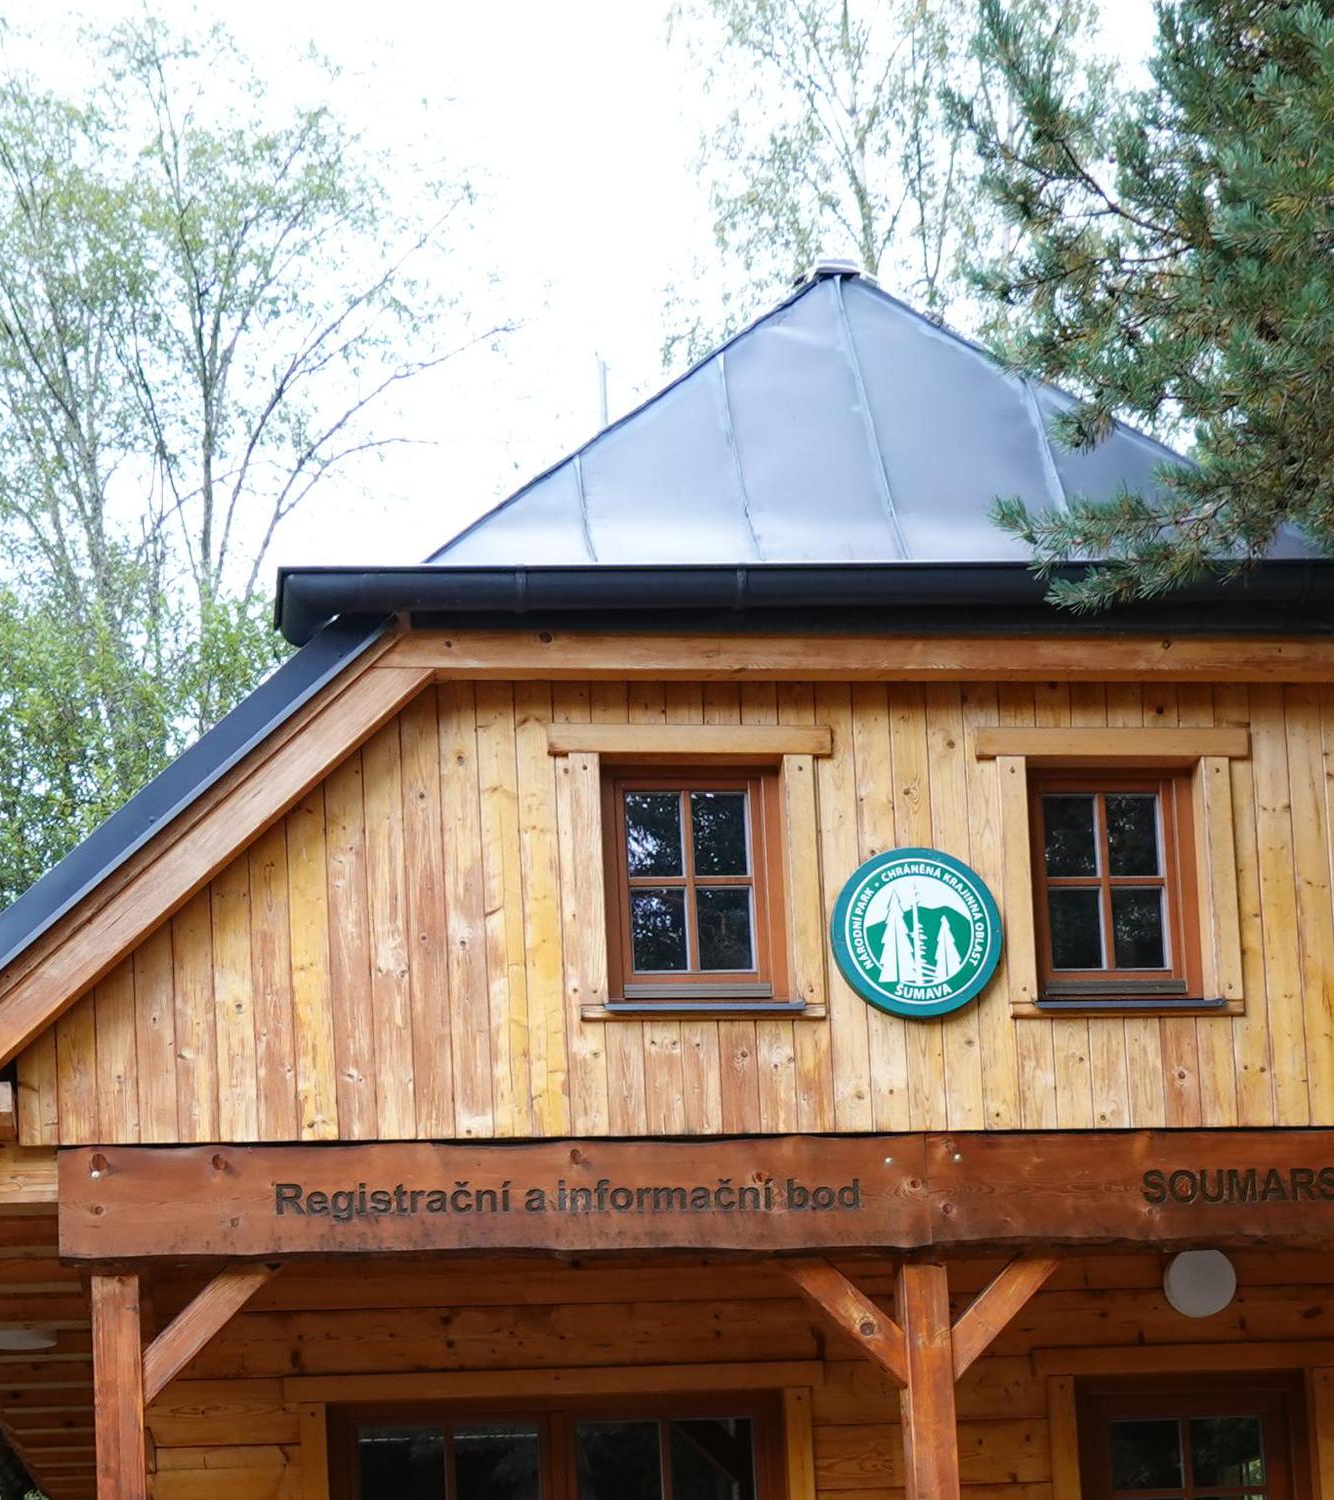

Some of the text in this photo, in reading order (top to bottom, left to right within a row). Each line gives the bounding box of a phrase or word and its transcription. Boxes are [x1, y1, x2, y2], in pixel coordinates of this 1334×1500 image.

[852, 864, 985, 970] NÁRODNÍ PARK CHRÁNĚNÁ KRAJINNÁ OBLAST
[274, 1178, 861, 1223] Registrační a informační bod
